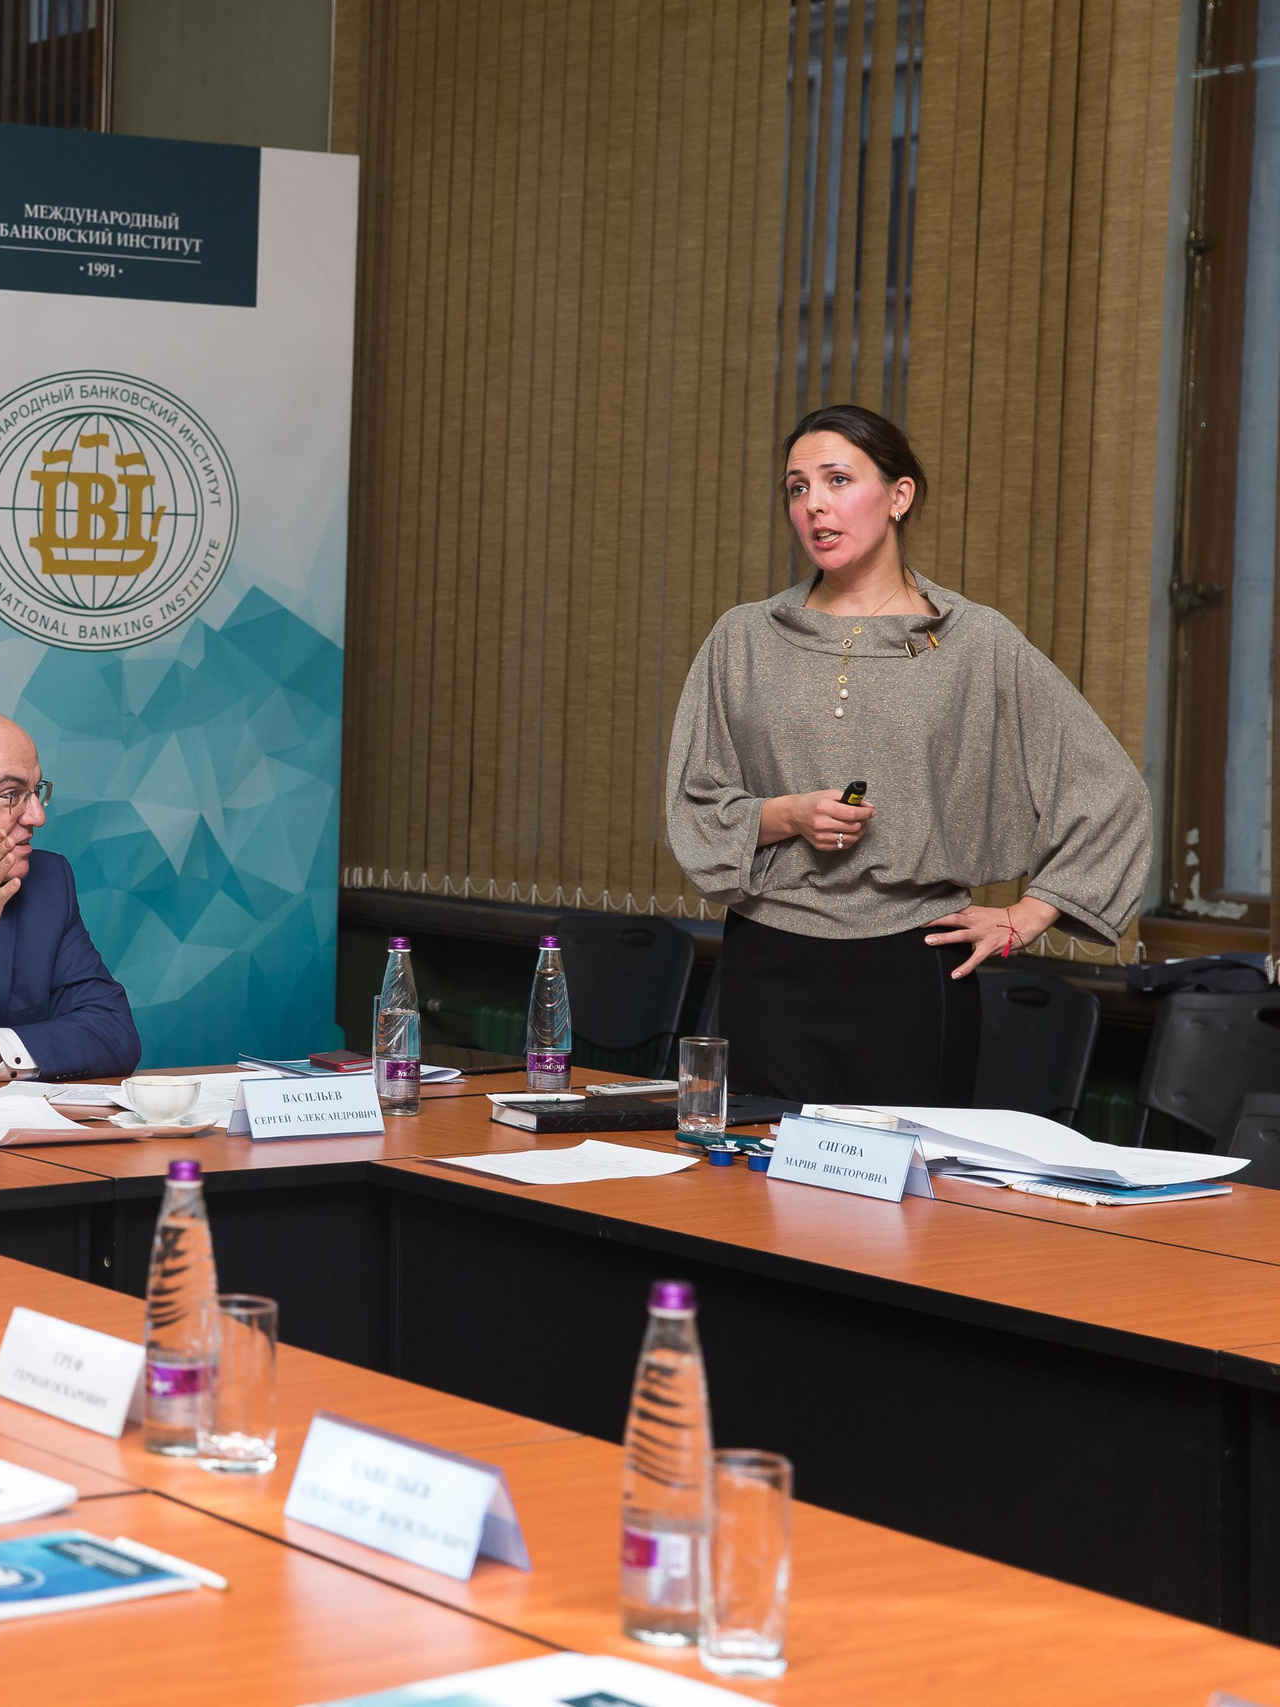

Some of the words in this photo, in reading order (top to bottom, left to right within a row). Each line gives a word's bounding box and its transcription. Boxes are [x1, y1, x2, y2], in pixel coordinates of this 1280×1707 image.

[24, 203, 180, 231] МЕЖДУНАРОДНЫЙ
[0, 222, 112, 246] БАНКОВСКИЙ
[116, 232, 203, 256] ИНСТИТУТ
[86, 262, 116, 278] 1991
[80, 384, 179, 428] БАНКОВСКИЙ
[178, 424, 222, 508] ИНСТИТУТ
[78, 614, 154, 640] BANKING
[160, 538, 221, 620] INSTITUTE
[282, 1090, 343, 1103] ВАСИЛЬЕВ
[254, 1113, 292, 1125] СЕРГЕЙ
[296, 1110, 377, 1123] АЛЕКСАНДРОВИЧ
[818, 1139, 864, 1158] СИГОВА
[784, 1156, 817, 1171] МАРИЯ
[823, 1163, 888, 1184] ВИКТОРОВНА
